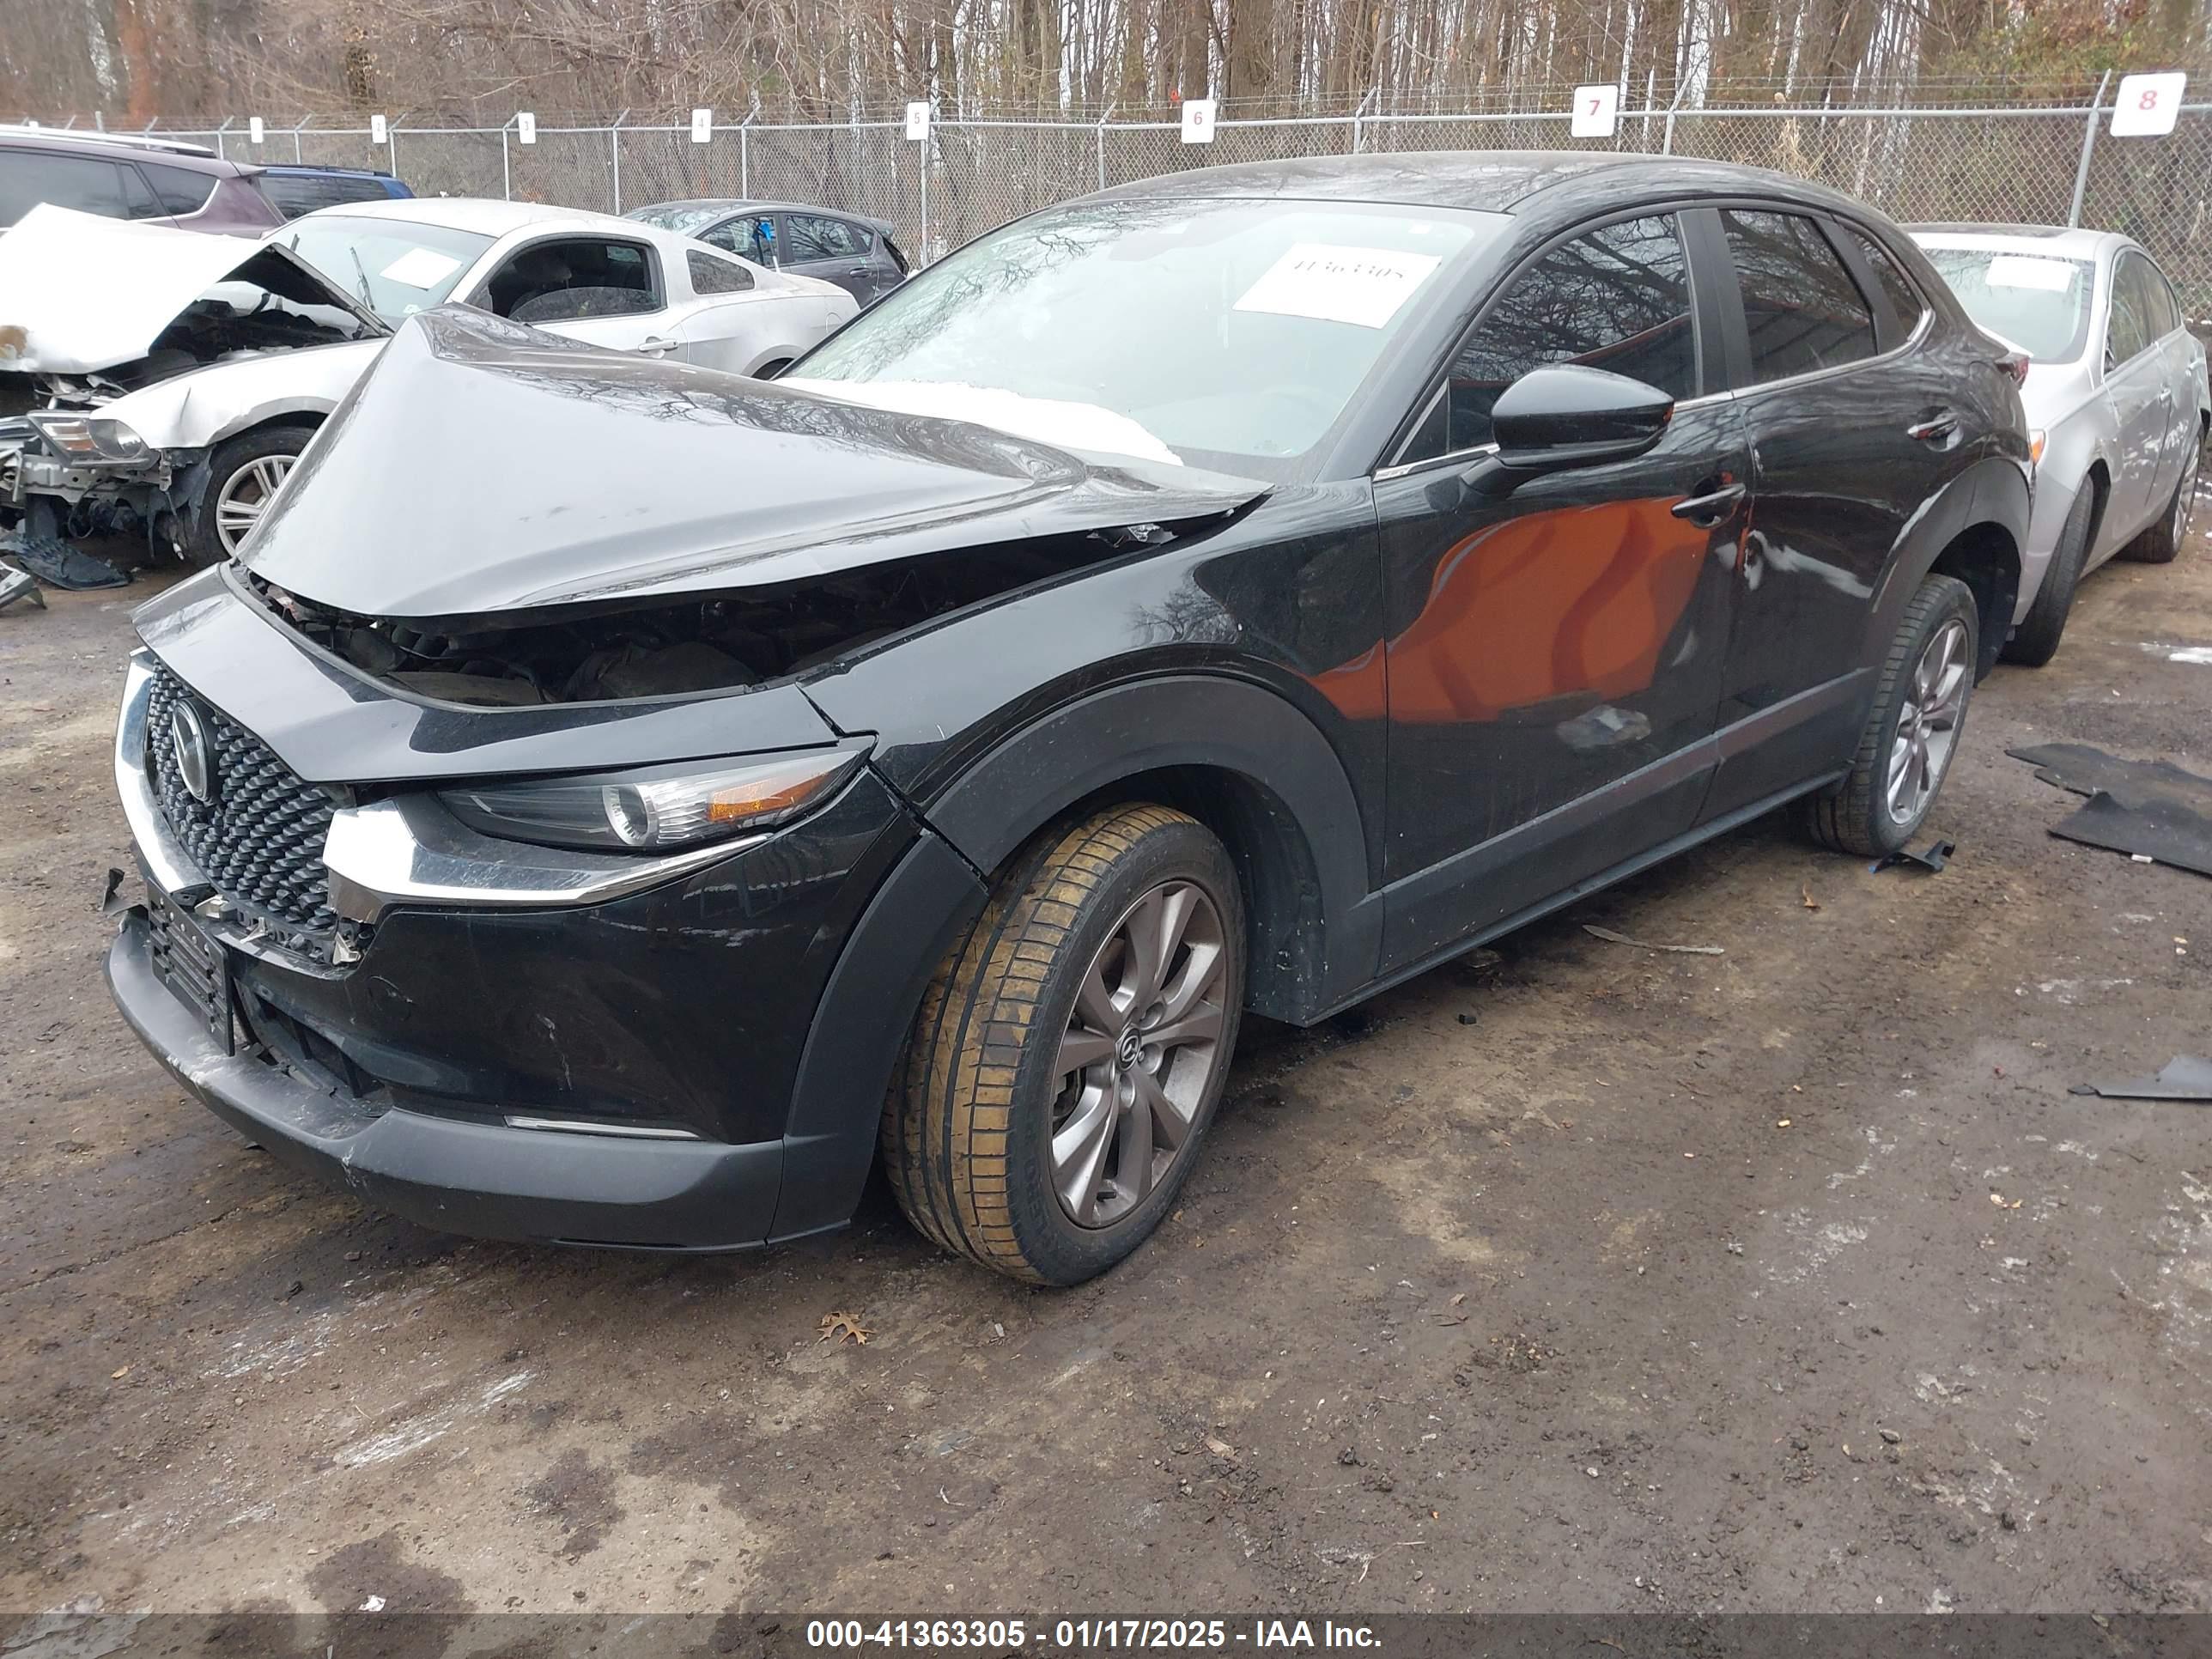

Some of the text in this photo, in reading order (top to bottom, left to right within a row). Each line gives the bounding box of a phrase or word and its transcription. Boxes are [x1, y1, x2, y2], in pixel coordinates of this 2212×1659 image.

[1589, 99, 1601, 116] 7
[2139, 90, 2158, 110] 8
[914, 112, 921, 125] 5
[1194, 111, 1203, 125] 6
